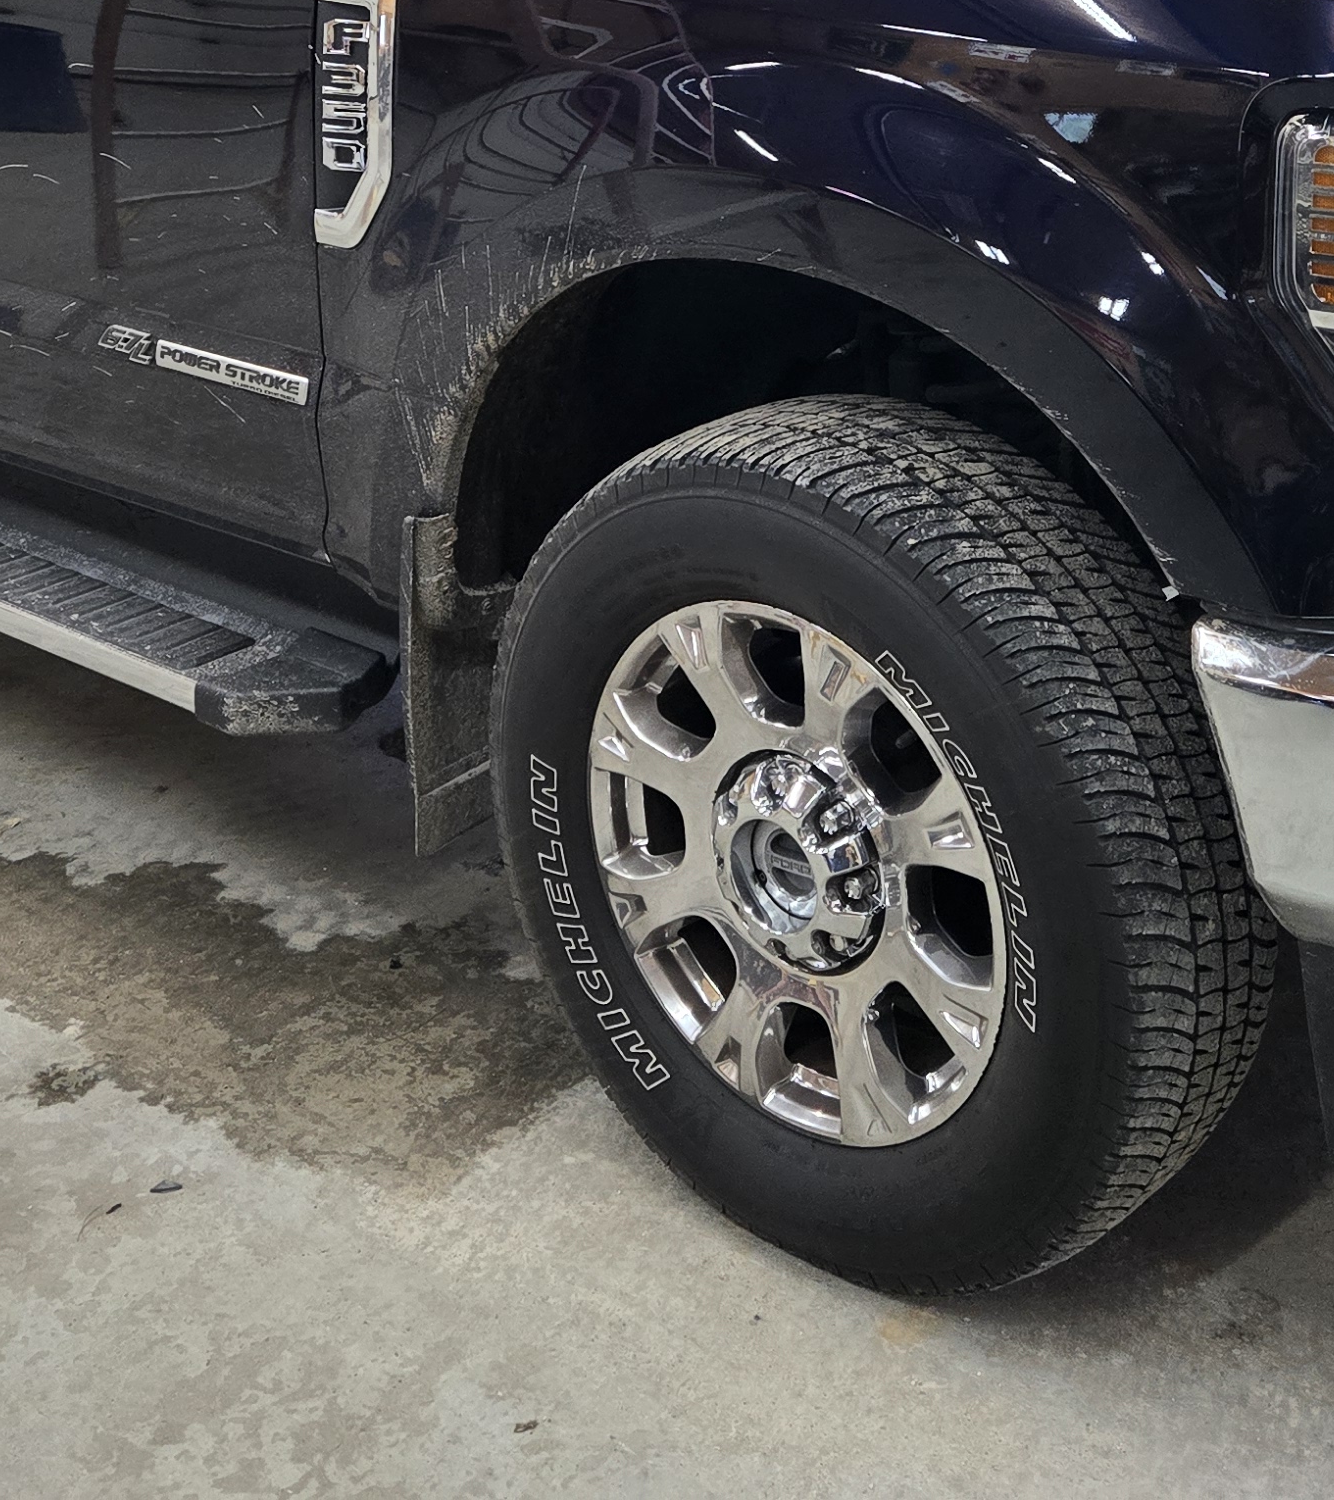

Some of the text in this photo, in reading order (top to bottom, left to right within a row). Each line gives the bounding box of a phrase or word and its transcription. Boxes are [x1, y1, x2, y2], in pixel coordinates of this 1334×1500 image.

[321, 18, 371, 173] F350
[98, 324, 301, 396] 6.7L POWER STROKE
[770, 855, 812, 876] FORD
[874, 650, 1039, 1032] MICHELIN
[528, 753, 670, 1091] MICHELIN
